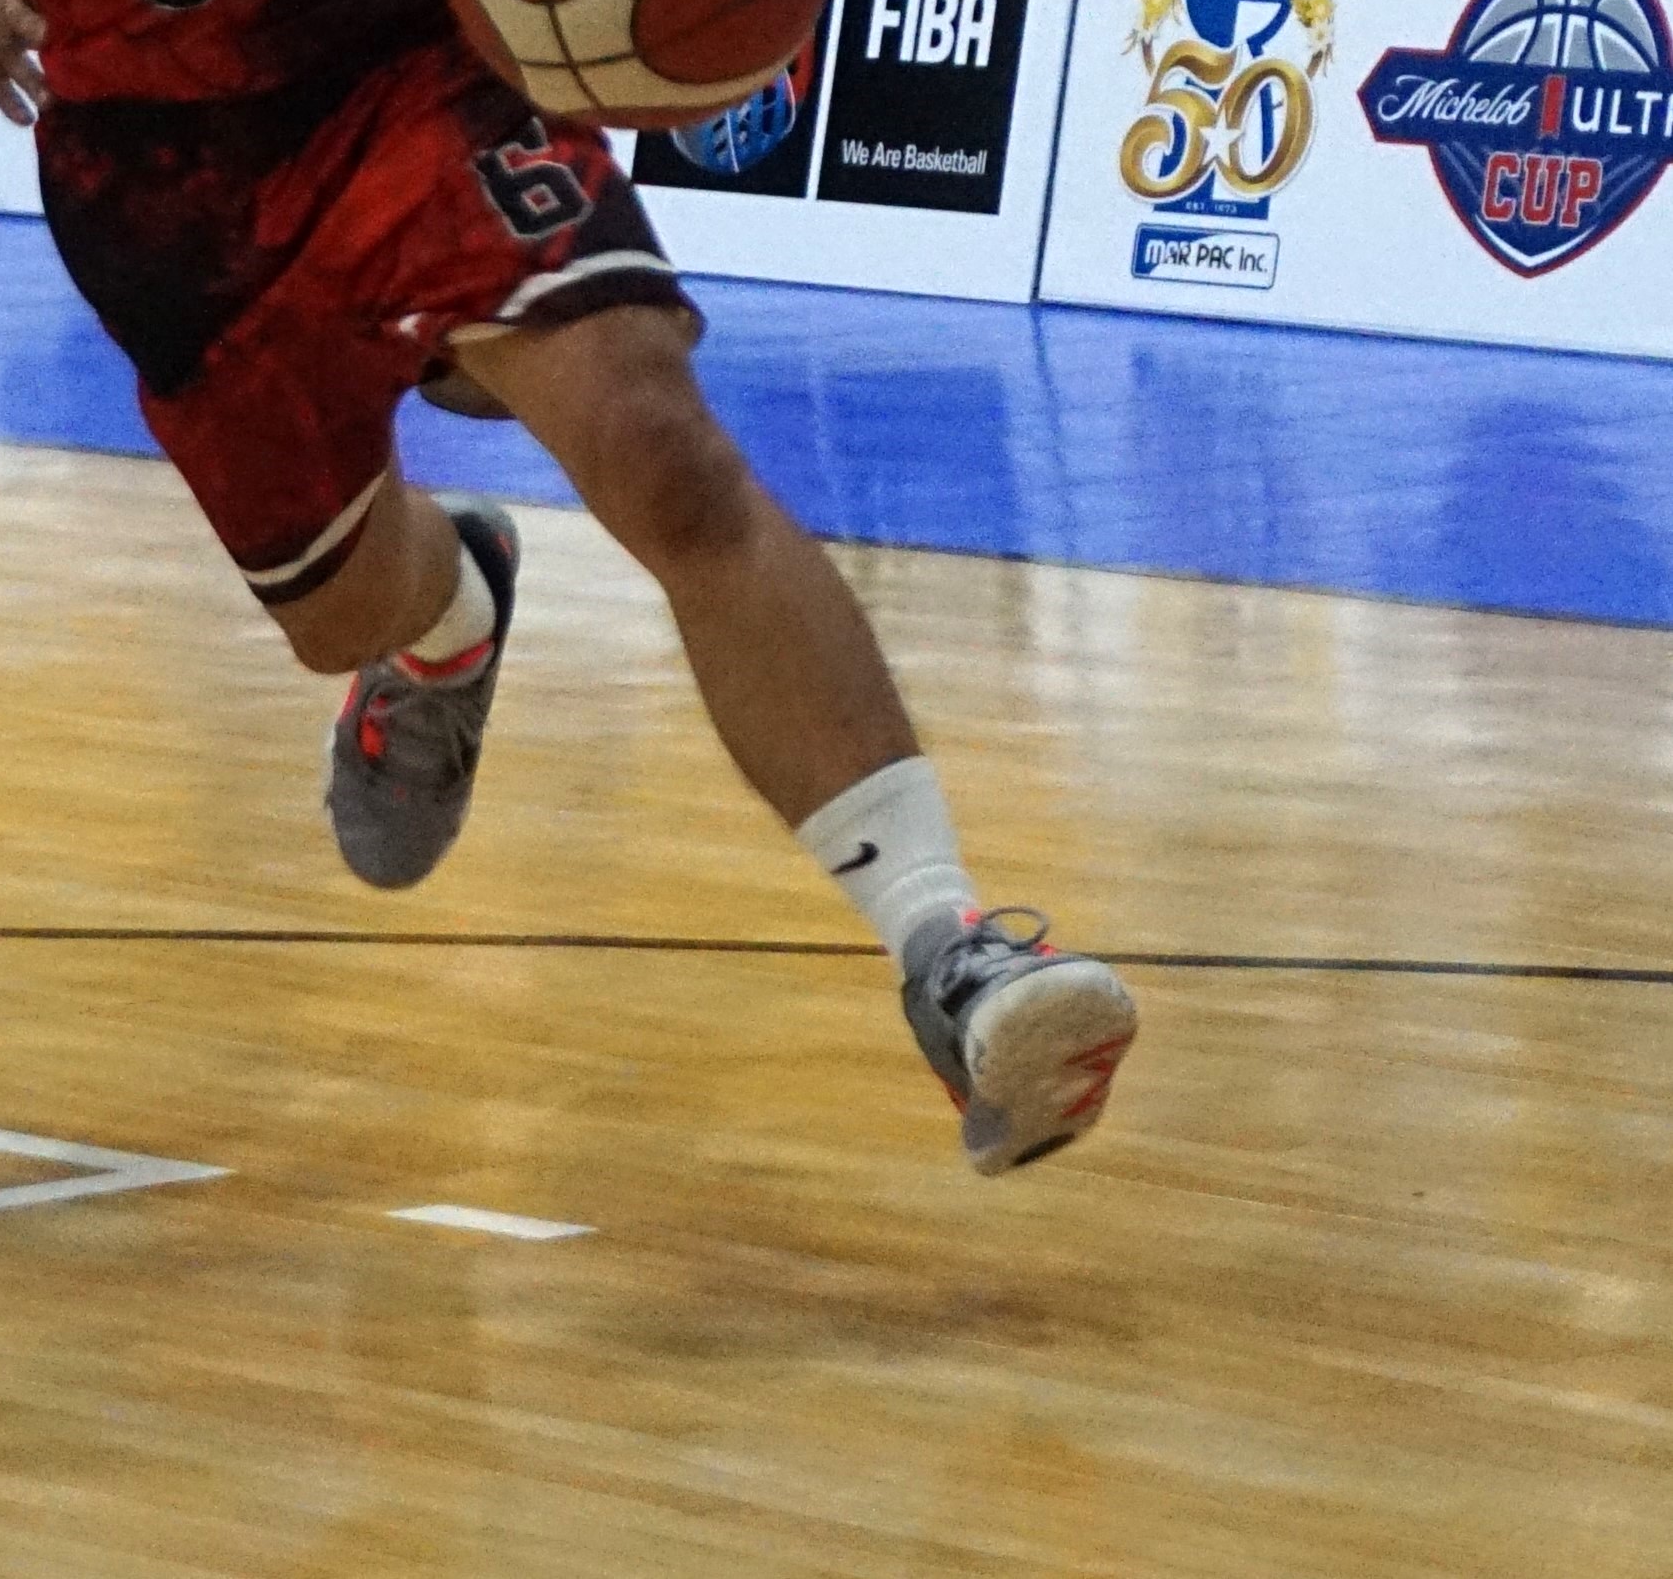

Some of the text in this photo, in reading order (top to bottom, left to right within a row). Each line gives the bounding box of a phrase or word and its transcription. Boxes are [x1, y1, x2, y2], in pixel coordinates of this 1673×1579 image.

[1119, 39, 1316, 200] 50
[1379, 75, 1539, 125] Michelob
[471, 116, 594, 240] 6
[841, 138, 988, 175] We Are Basketball
[1483, 151, 1603, 228] CUP
[1195, 243, 1235, 270] PAC
[1238, 246, 1268, 273] Inc.
